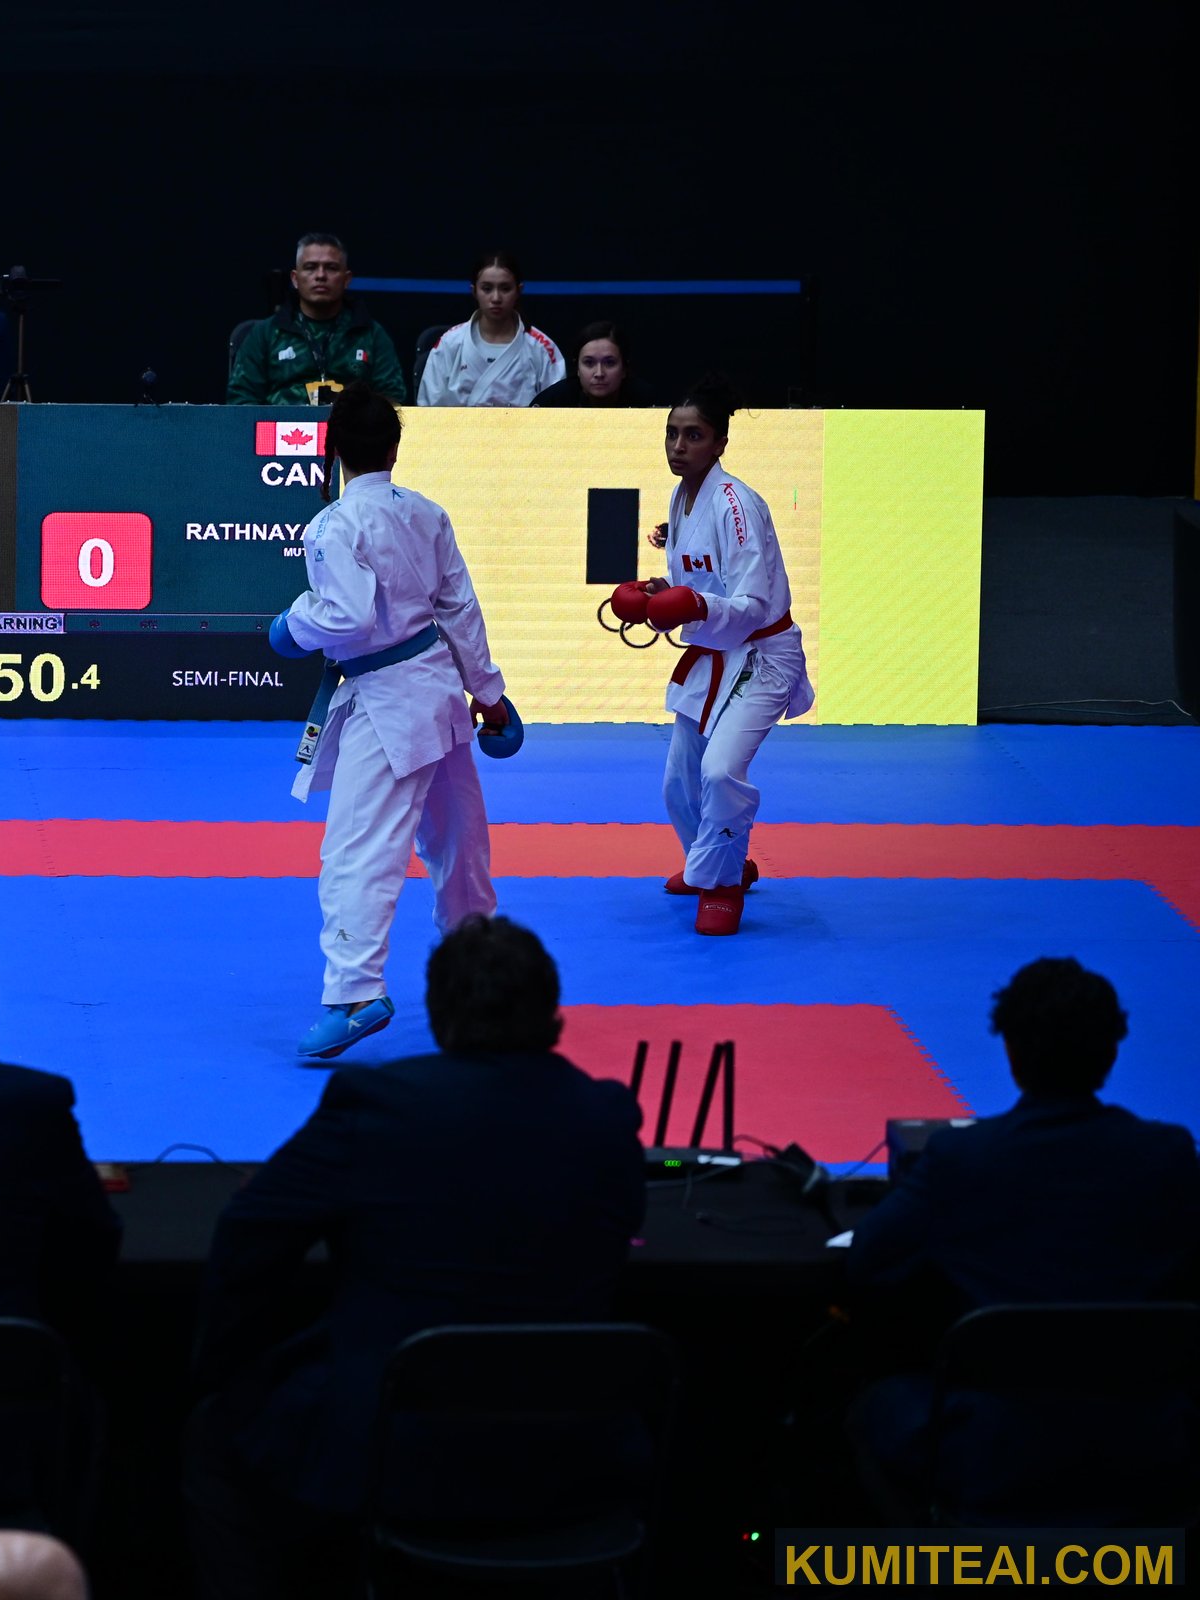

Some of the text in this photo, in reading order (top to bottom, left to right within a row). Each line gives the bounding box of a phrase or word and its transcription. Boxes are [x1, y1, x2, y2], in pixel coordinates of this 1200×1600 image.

[261, 462, 326, 487] CAN
[78, 537, 115, 587] 0
[172, 671, 284, 687] SEMI-FINAL
